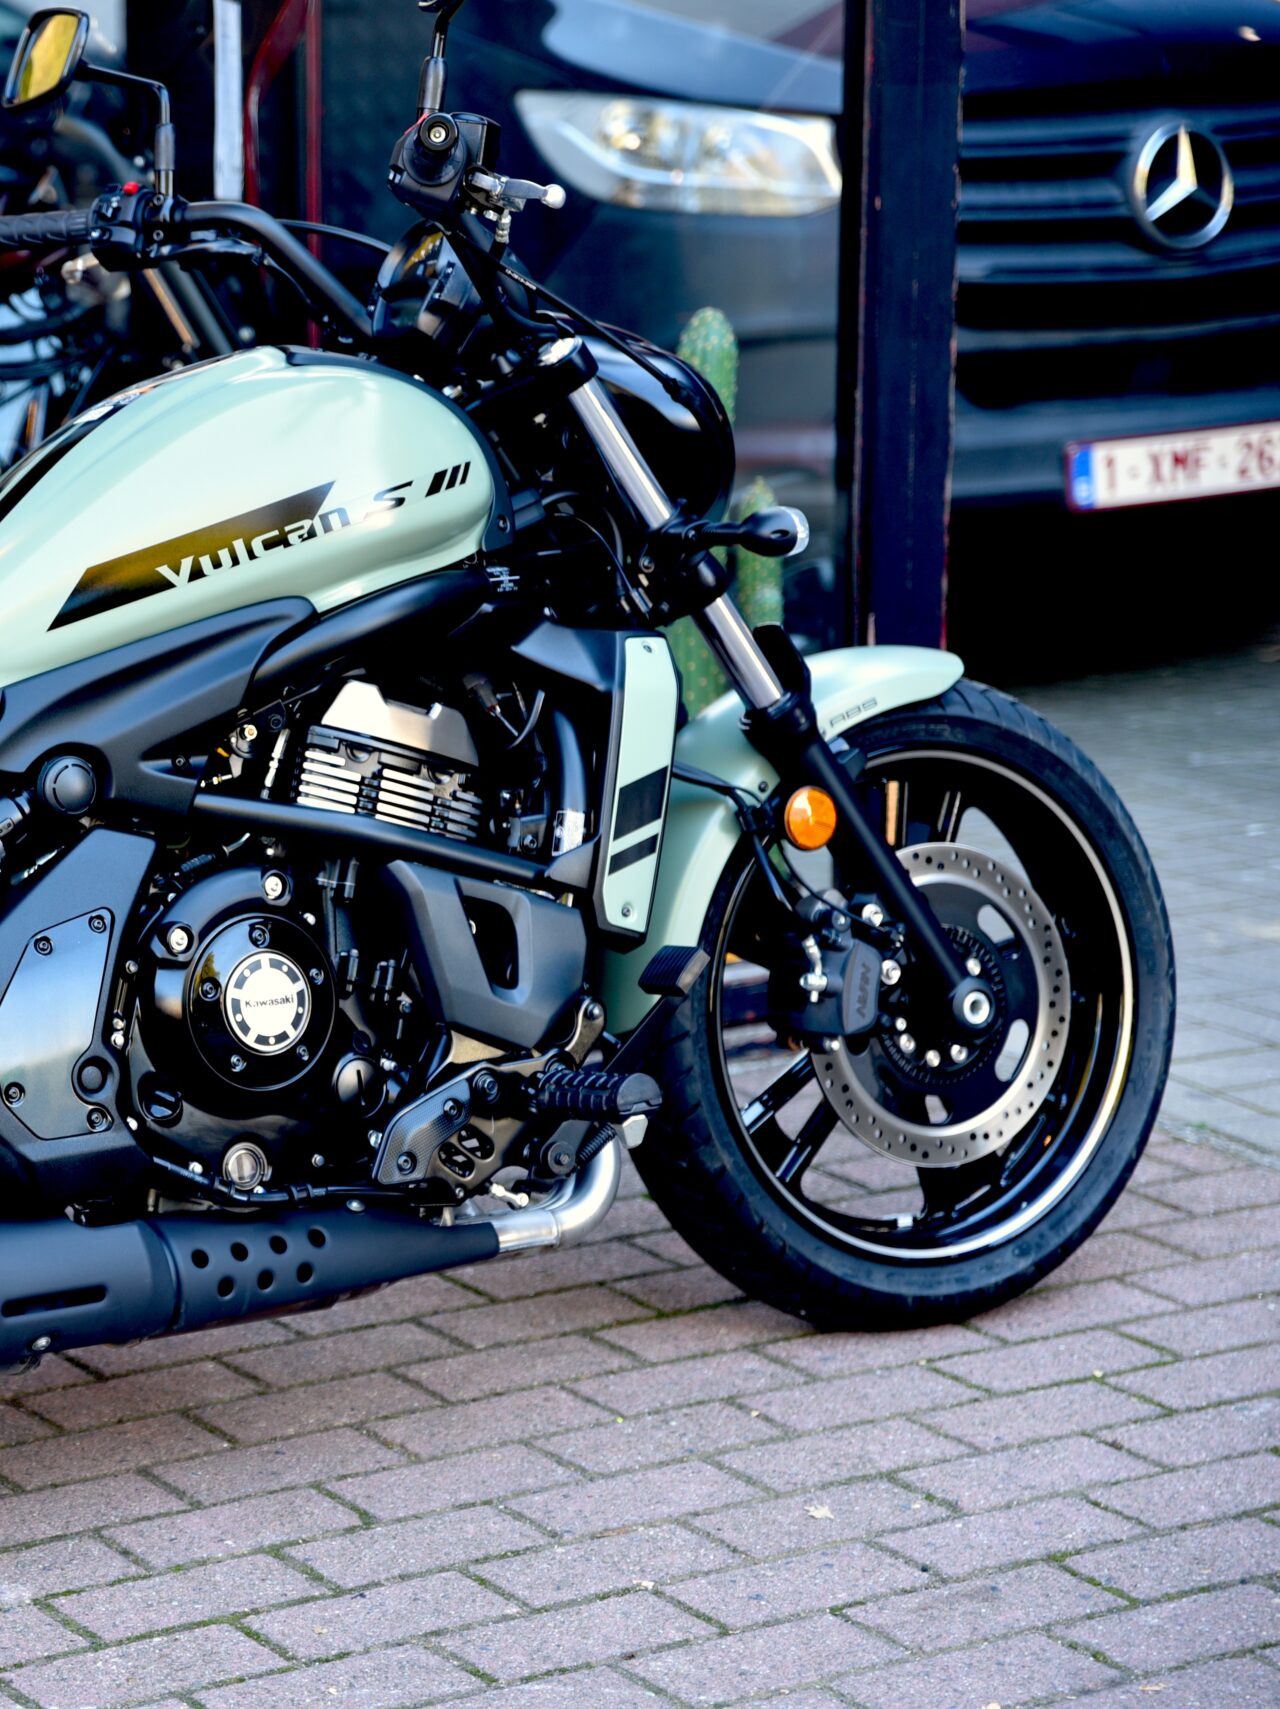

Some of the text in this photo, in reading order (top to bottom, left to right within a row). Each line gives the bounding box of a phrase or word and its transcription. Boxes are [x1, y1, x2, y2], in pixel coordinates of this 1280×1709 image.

[155, 479, 414, 587] Vulcan S
[829, 697, 878, 728] ABS
[245, 994, 294, 1008] Kawasaki
